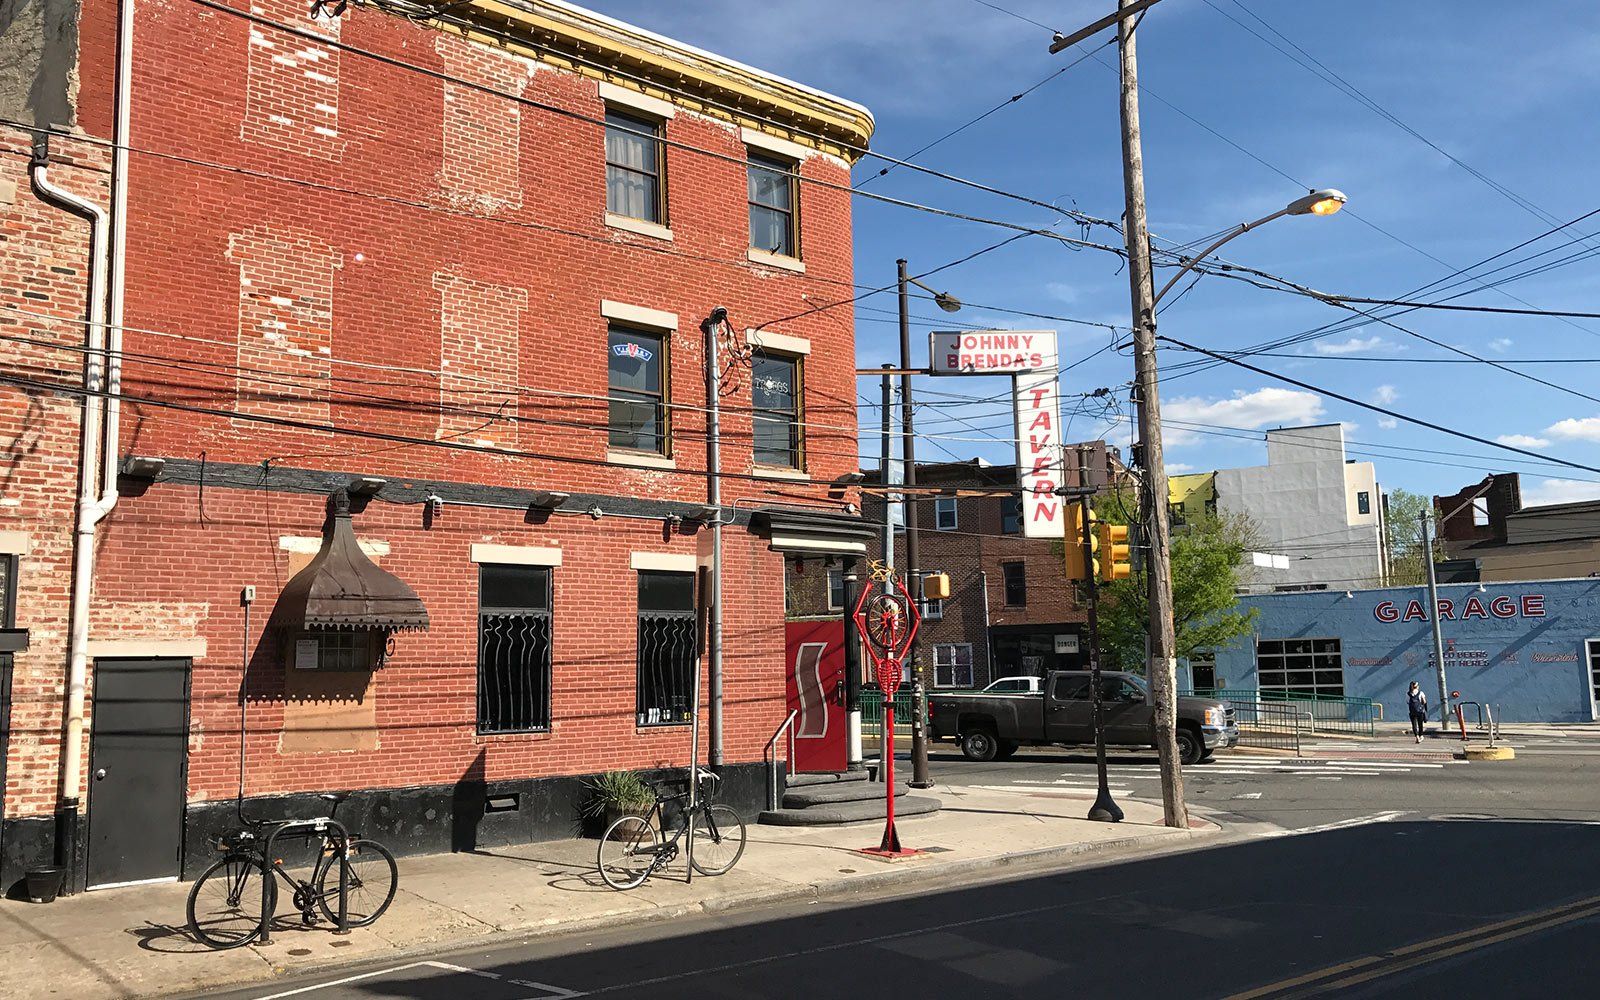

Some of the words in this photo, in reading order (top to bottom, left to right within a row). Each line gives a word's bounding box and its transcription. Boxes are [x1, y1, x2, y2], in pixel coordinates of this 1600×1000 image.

[950, 335, 1033, 350] JOHNNY
[947, 353, 1043, 368] BRENDA'S
[1029, 388, 1057, 522] TAVERN
[1374, 594, 1546, 623] GARAGE
[1428, 651, 1455, 659] CLD
[1456, 650, 1488, 659] BEERS
[1428, 659, 1456, 668] RHT
